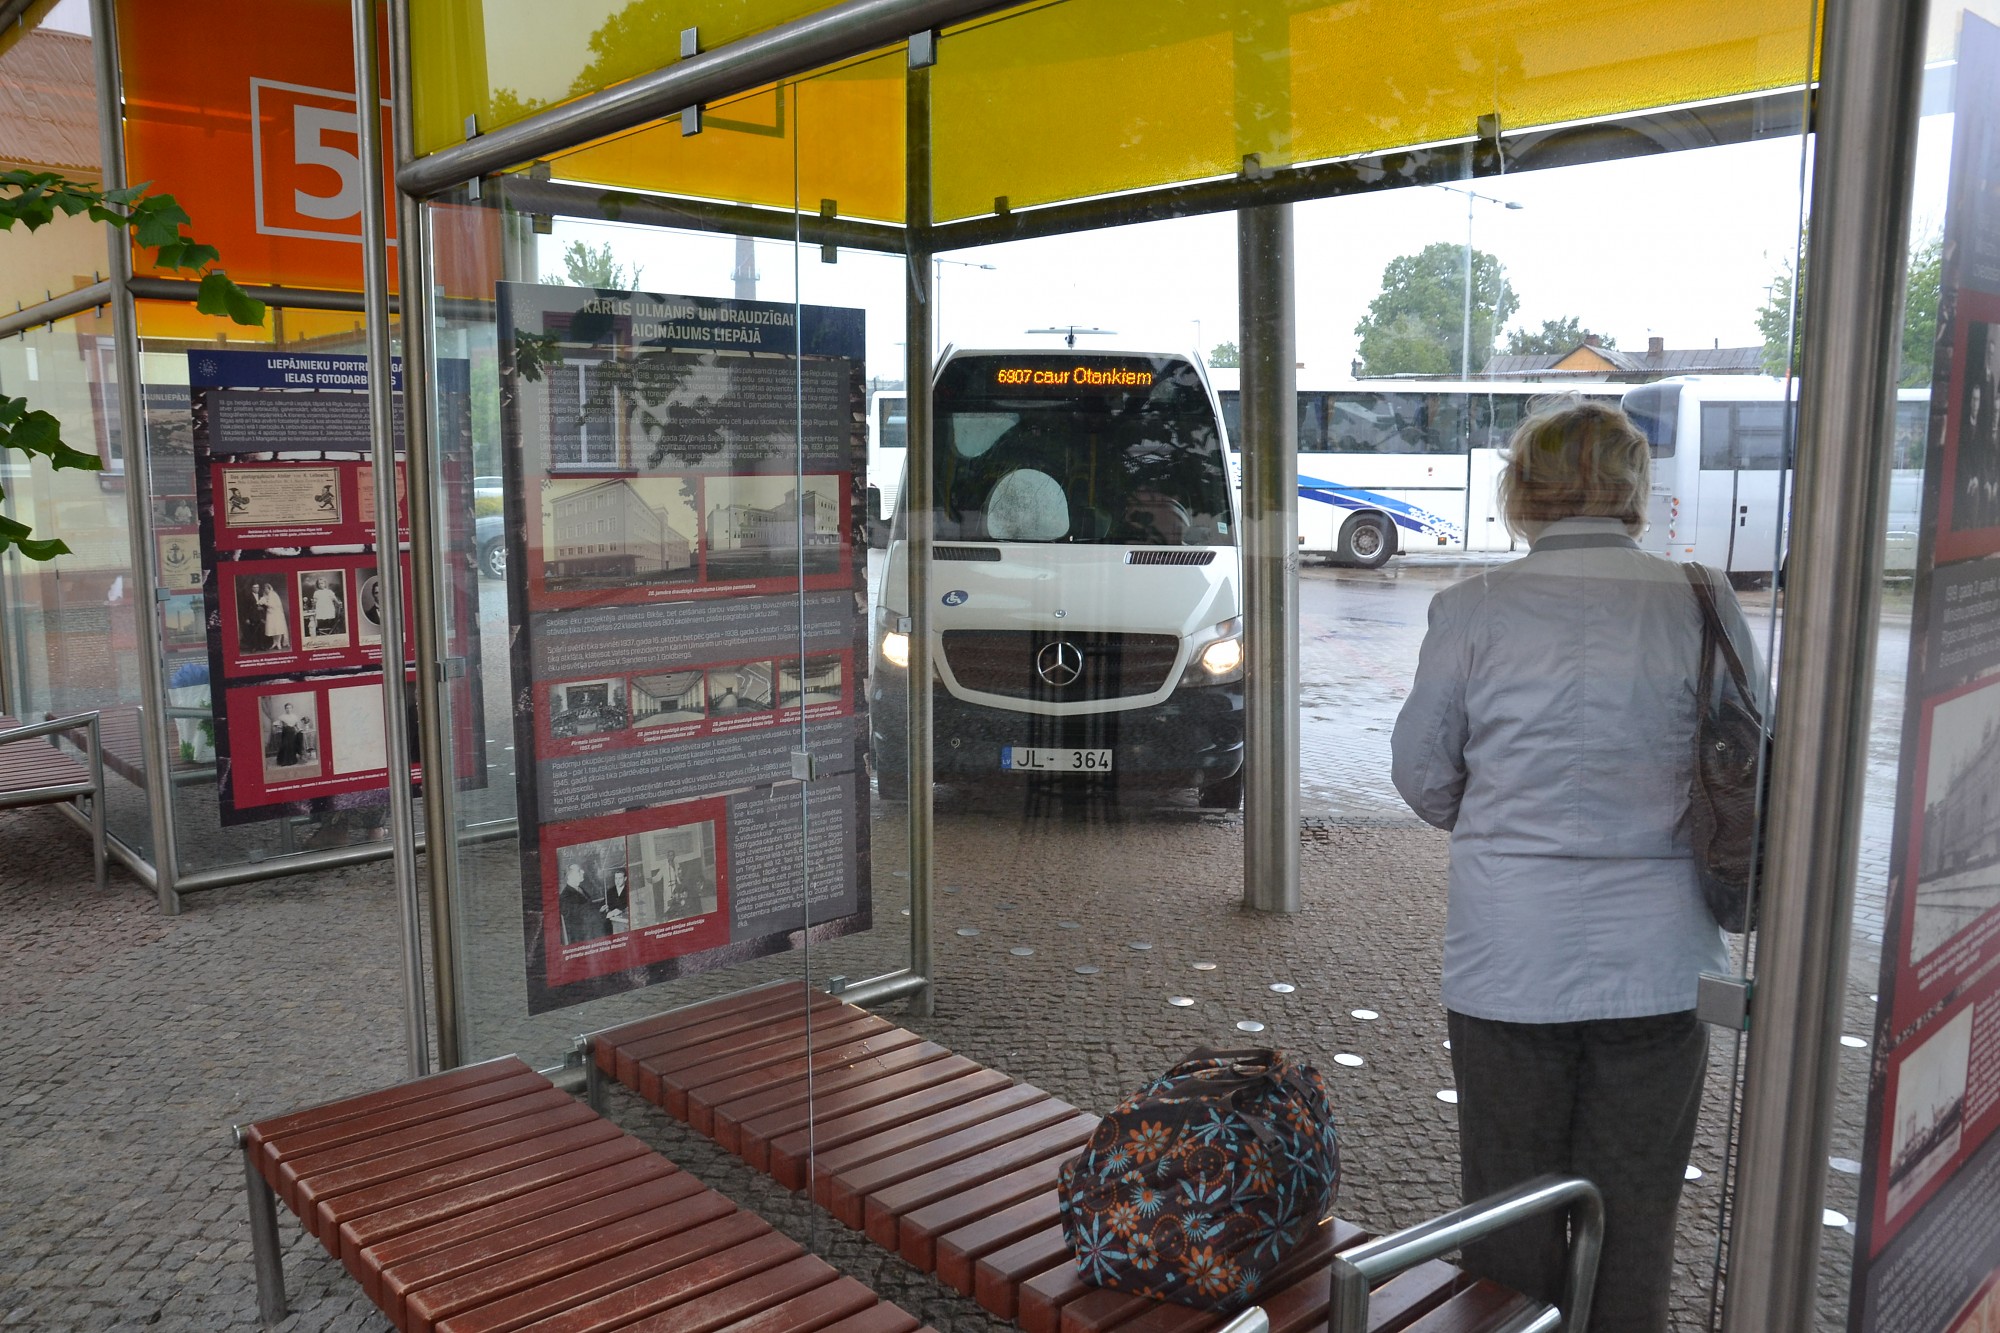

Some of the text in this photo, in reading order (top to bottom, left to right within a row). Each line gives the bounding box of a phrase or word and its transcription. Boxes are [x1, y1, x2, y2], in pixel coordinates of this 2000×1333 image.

[294, 104, 363, 220] 5
[583, 297, 796, 325] KĀRLIS ULMANIS UN DRAUDZĪGAI
[631, 320, 760, 343] AICINĀJUMS LIEPĀJĀ
[267, 358, 330, 371] LIEPĀJNIEKU
[284, 373, 314, 382] IELAS
[998, 367, 1152, 385] 6907 caur Otankiem
